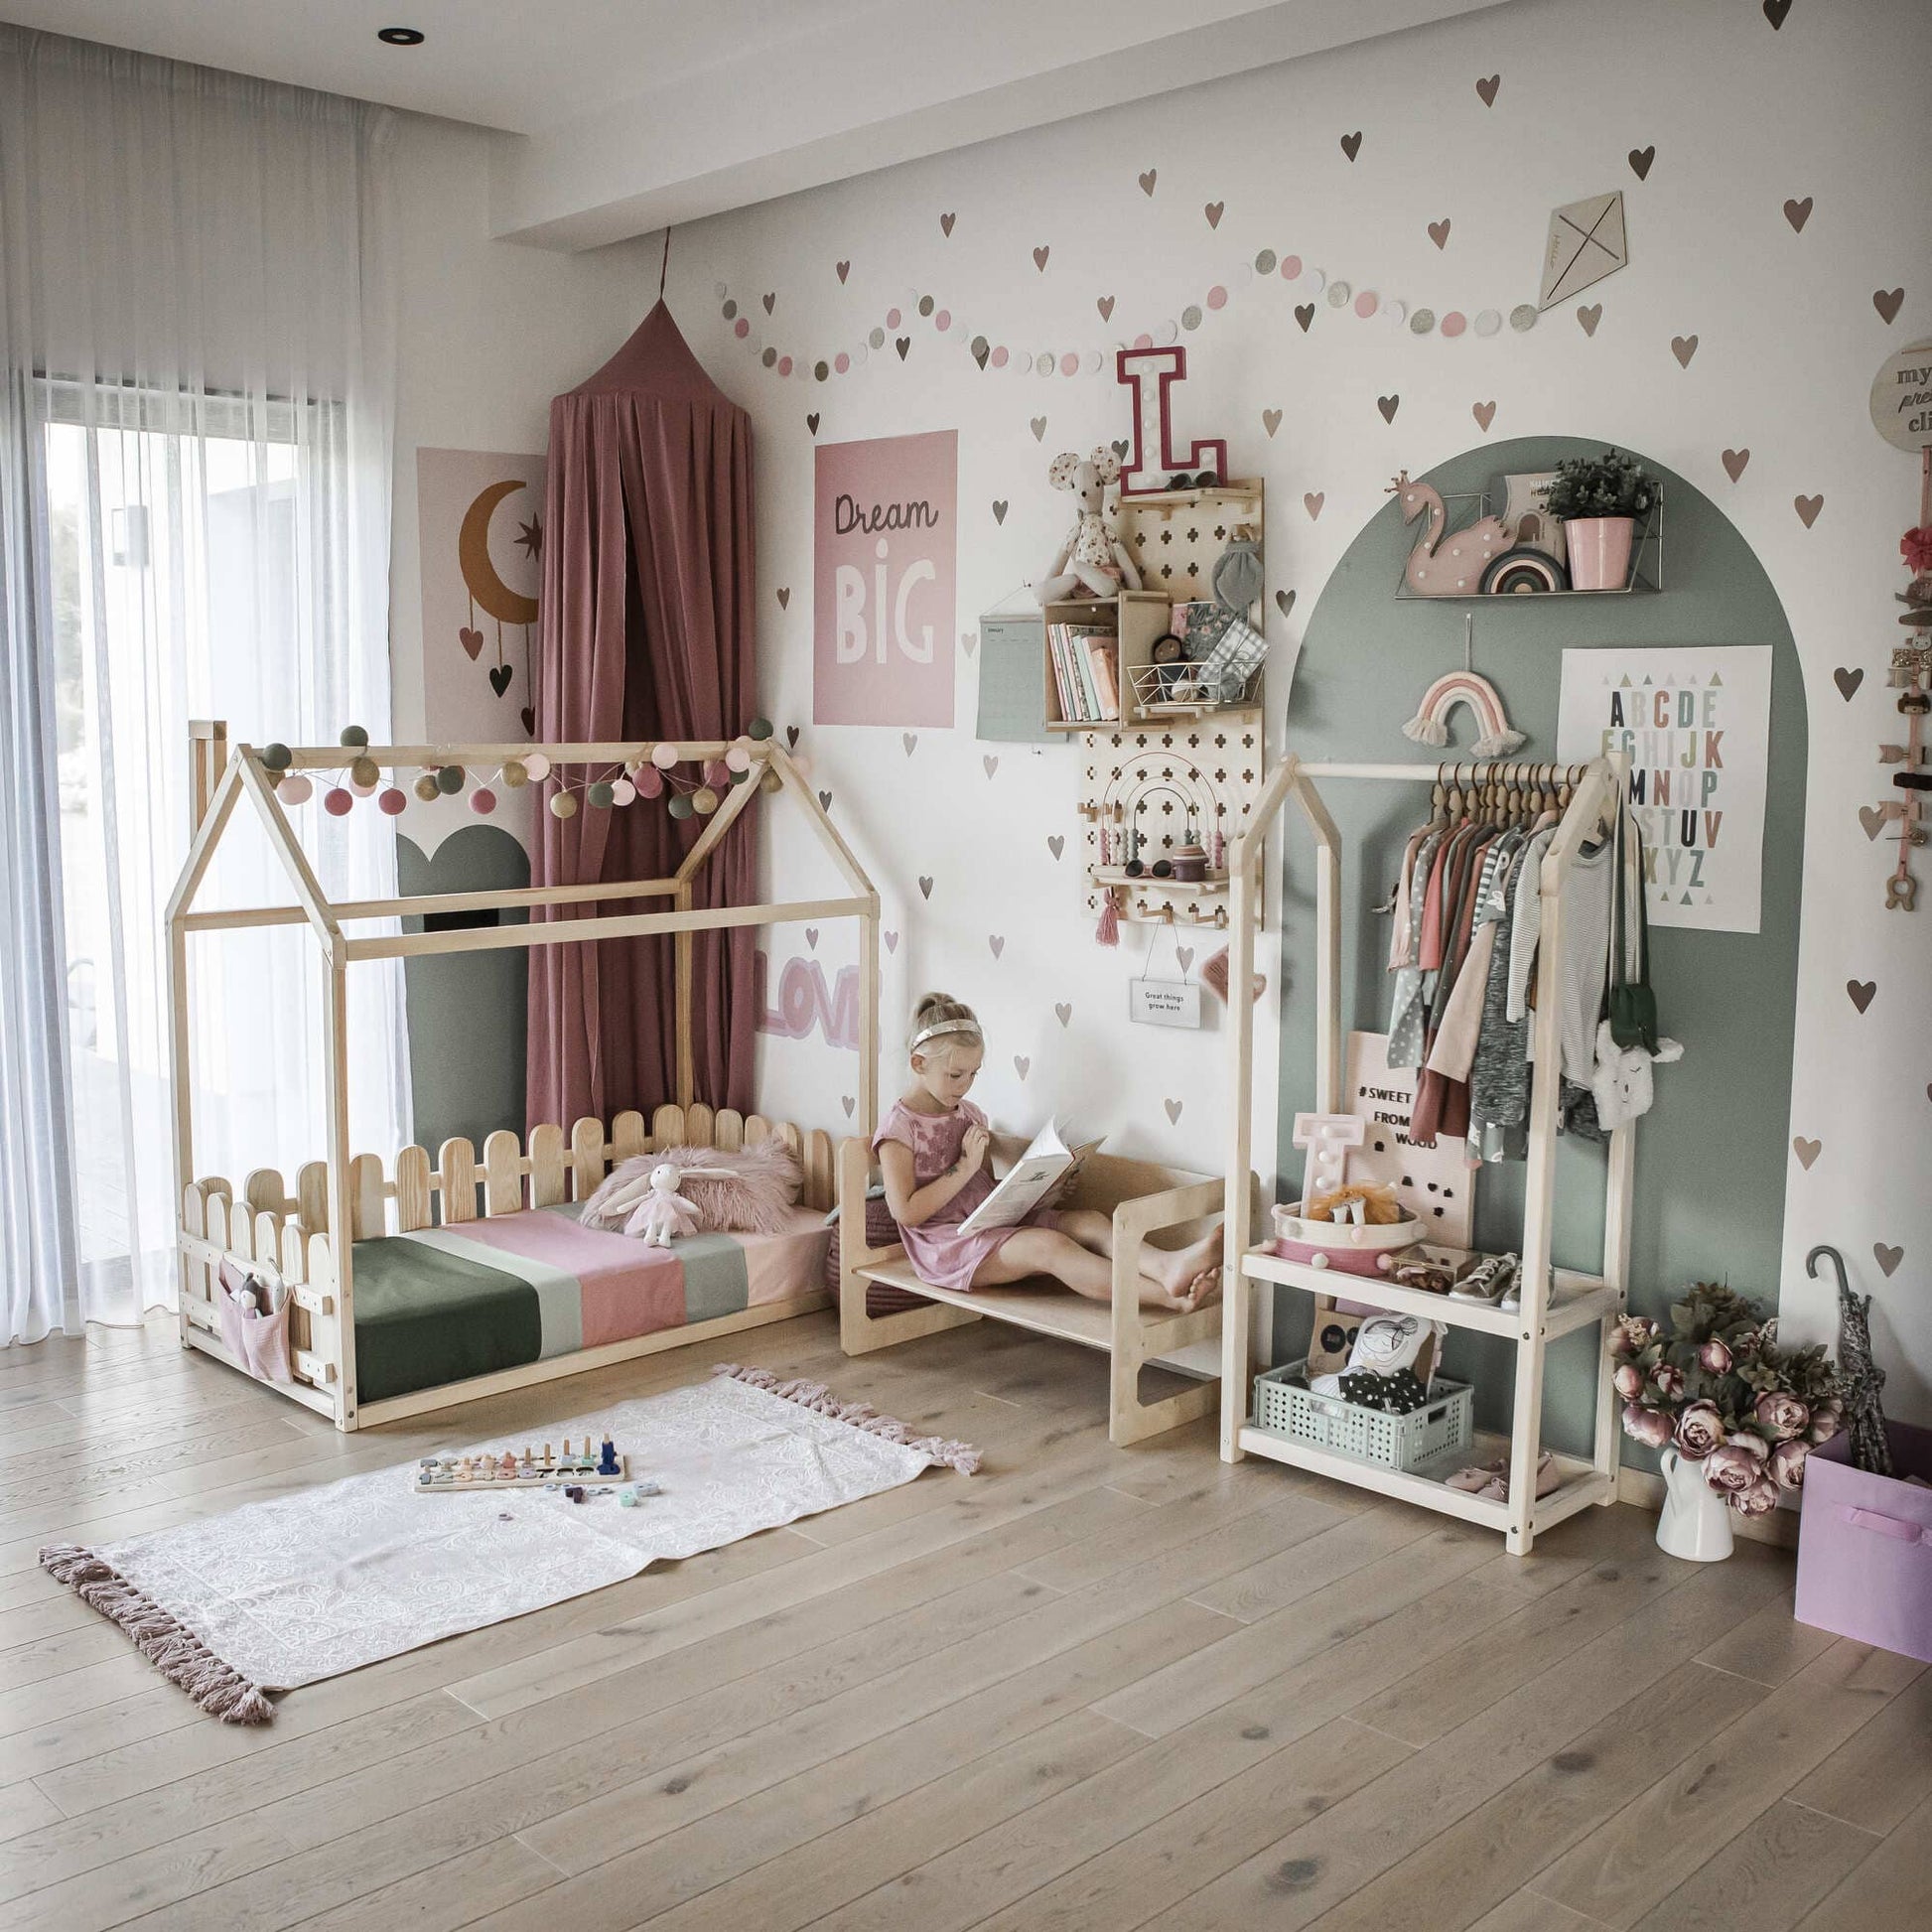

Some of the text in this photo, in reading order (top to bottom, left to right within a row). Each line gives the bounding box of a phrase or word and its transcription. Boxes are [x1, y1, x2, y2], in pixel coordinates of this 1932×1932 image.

[1897, 366, 1932, 385] my
[1898, 390, 1932, 414] pre
[835, 493, 939, 535] Dream
[1628, 768, 1718, 808] MNOP
[1643, 847, 1706, 888] XYZ
[1145, 991, 1184, 1004] Great things
[1166, 1003, 1180, 1012] here
[1373, 1111, 1411, 1127] FROM
